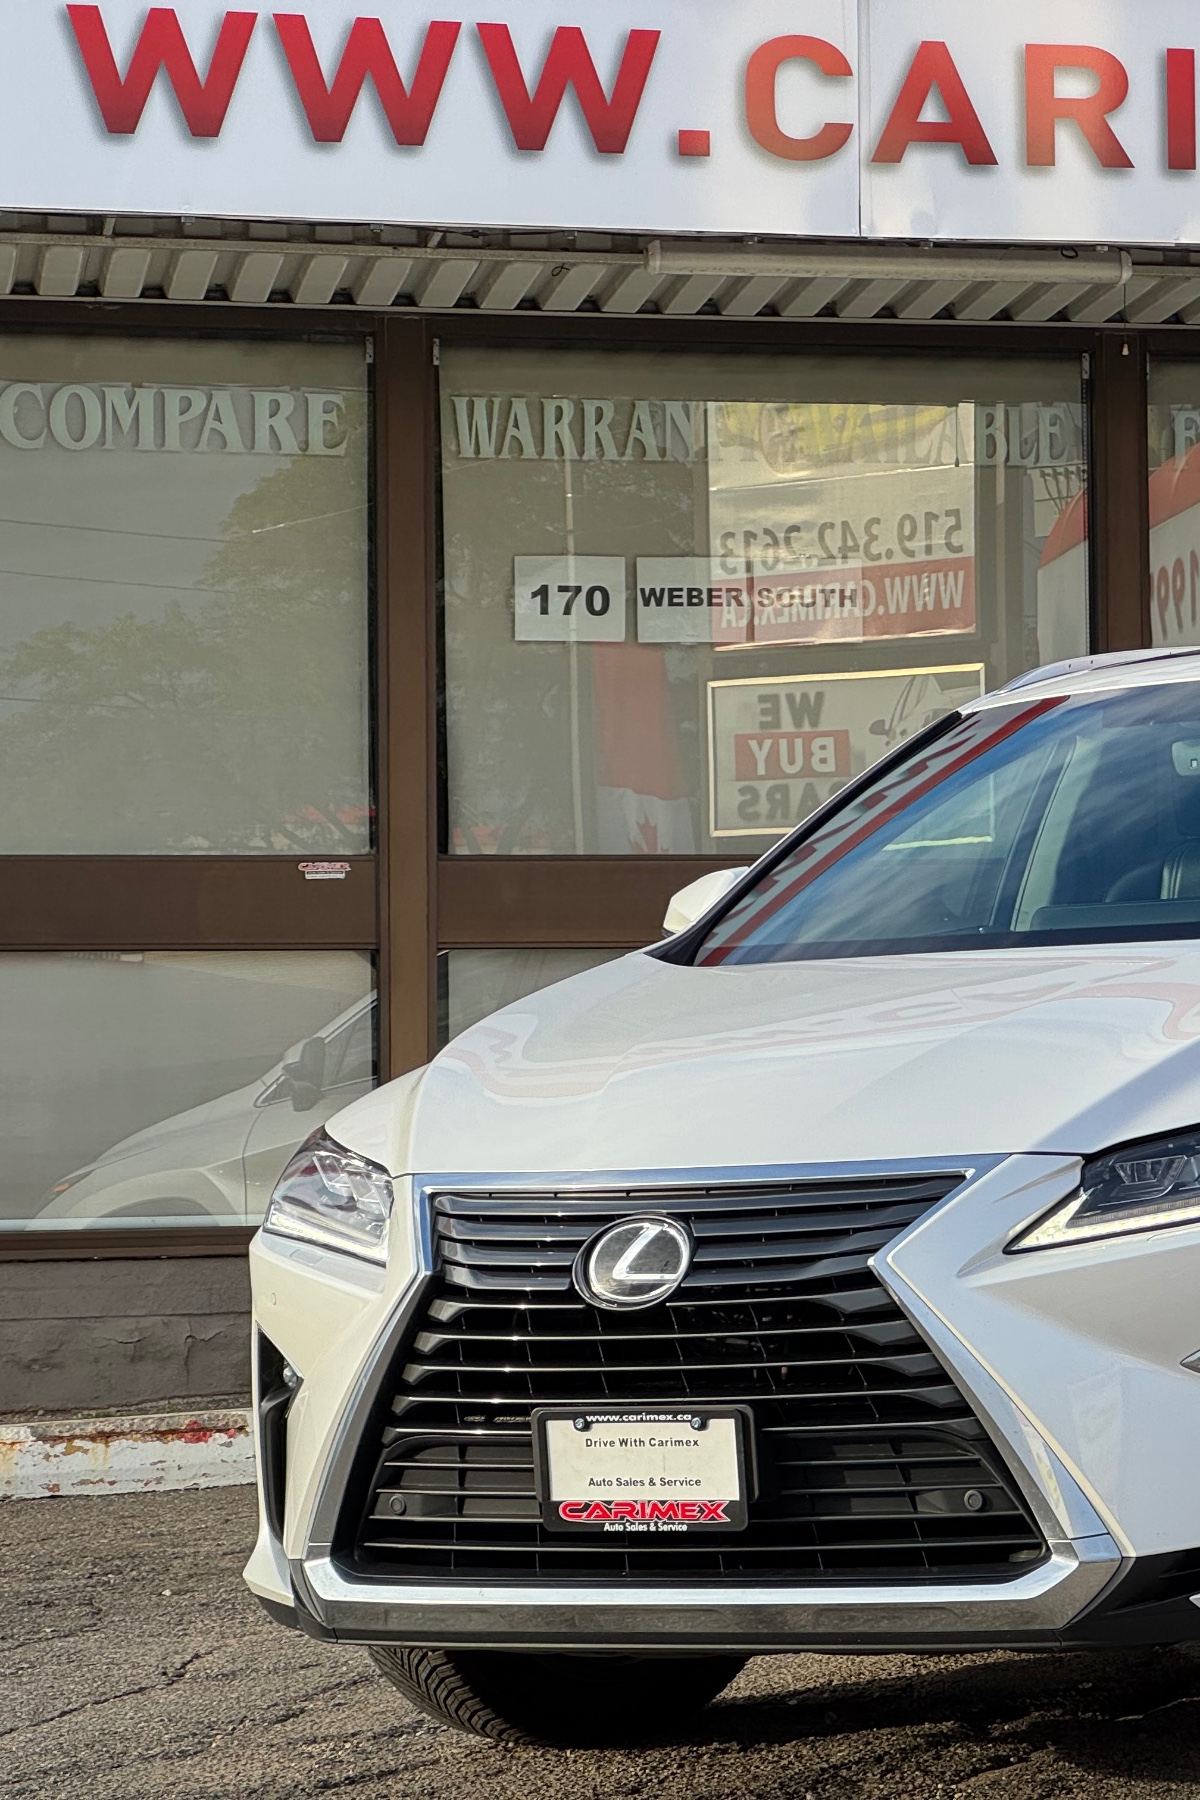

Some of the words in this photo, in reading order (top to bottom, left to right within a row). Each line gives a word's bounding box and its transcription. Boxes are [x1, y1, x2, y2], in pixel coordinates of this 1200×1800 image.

[0, 383, 347, 456] COMPARE
[530, 584, 611, 617] 170
[639, 587, 745, 607] WEBER
[757, 587, 857, 608] SOUTH
[585, 1412, 692, 1422] www.carimex.ca
[585, 1438, 616, 1447] Drive
[618, 1437, 646, 1447] With
[648, 1437, 700, 1447] Carimex
[588, 1477, 613, 1487] Auto
[615, 1477, 646, 1487] Sales
[648, 1477, 657, 1487] &
[659, 1476, 702, 1487] Service
[559, 1501, 729, 1521] CARIMEX
[603, 1522, 624, 1532] Auto
[625, 1522, 648, 1532] Sales
[649, 1523, 656, 1531] &
[657, 1522, 688, 1532] Service
